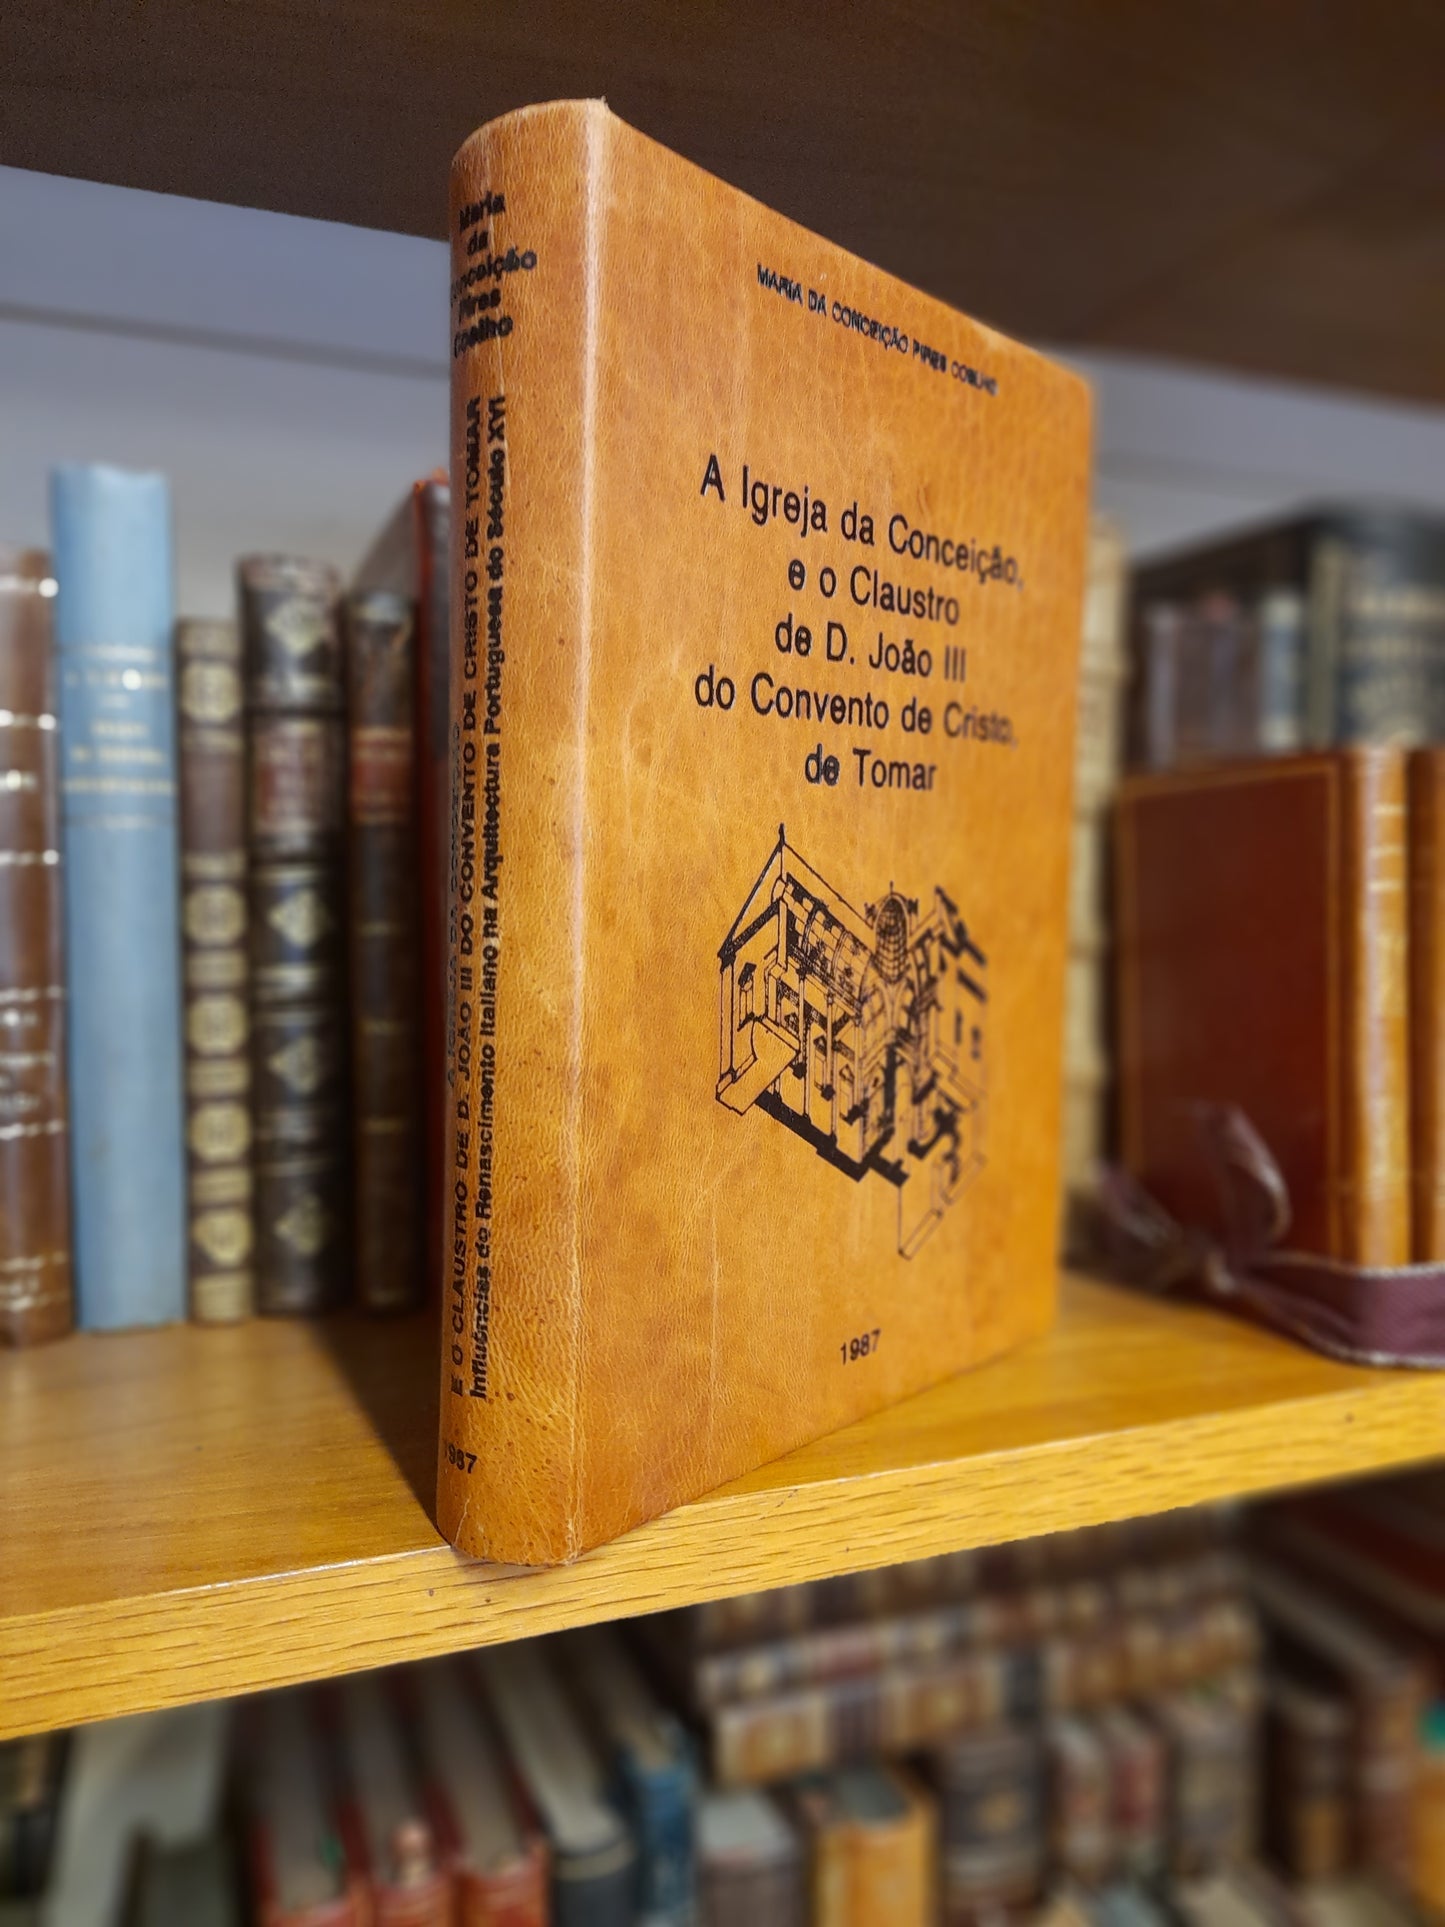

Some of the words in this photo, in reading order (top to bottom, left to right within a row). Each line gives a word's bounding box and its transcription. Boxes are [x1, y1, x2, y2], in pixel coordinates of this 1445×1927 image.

[459, 190, 506, 231] Maria
[467, 230, 489, 256] da
[454, 315, 514, 358] Coelho
[757, 262, 804, 304] MARIA
[808, 288, 827, 316] DA
[832, 301, 909, 354] CONCEIÇÃO
[912, 338, 947, 373] PIRES
[951, 361, 999, 396] COELHO
[487, 395, 505, 443] XVI
[465, 395, 480, 508] TOMAR
[486, 448, 505, 540] Século
[700, 453, 725, 501] A
[742, 465, 828, 538] Igreja
[841, 502, 874, 546] da
[465, 516, 478, 559] DE
[486, 546, 504, 579] do
[788, 559, 806, 591] e
[819, 566, 836, 598] o
[850, 565, 960, 626] Claustro
[464, 569, 478, 679] CRISTO
[775, 612, 812, 657] de
[826, 621, 855, 665] D.
[869, 632, 932, 677] João
[943, 645, 966, 682] III
[483, 586, 504, 734] Portuguesa
[463, 689, 476, 730] DE
[695, 664, 735, 710] do
[751, 672, 889, 730] Convento
[901, 696, 932, 734] de
[804, 743, 840, 786] de
[852, 747, 937, 791] Tomar
[460, 740, 476, 902] CONVENTO
[481, 742, 503, 899] Arquitectura
[460, 913, 473, 955] DO
[483, 906, 497, 937] na
[459, 967, 472, 990] III
[480, 945, 498, 1035] Italiano
[456, 1001, 471, 1080] JOÃO
[456, 1094, 470, 1120] D.
[455, 1129, 468, 1169] DE
[475, 1044, 495, 1219] Renascimento
[451, 1180, 468, 1334] CLAUSTRO
[474, 1226, 490, 1258] do
[451, 1343, 463, 1365] O
[469, 1264, 490, 1399] Influências
[840, 1329, 881, 1366] 1987
[451, 1374, 463, 1396] E
